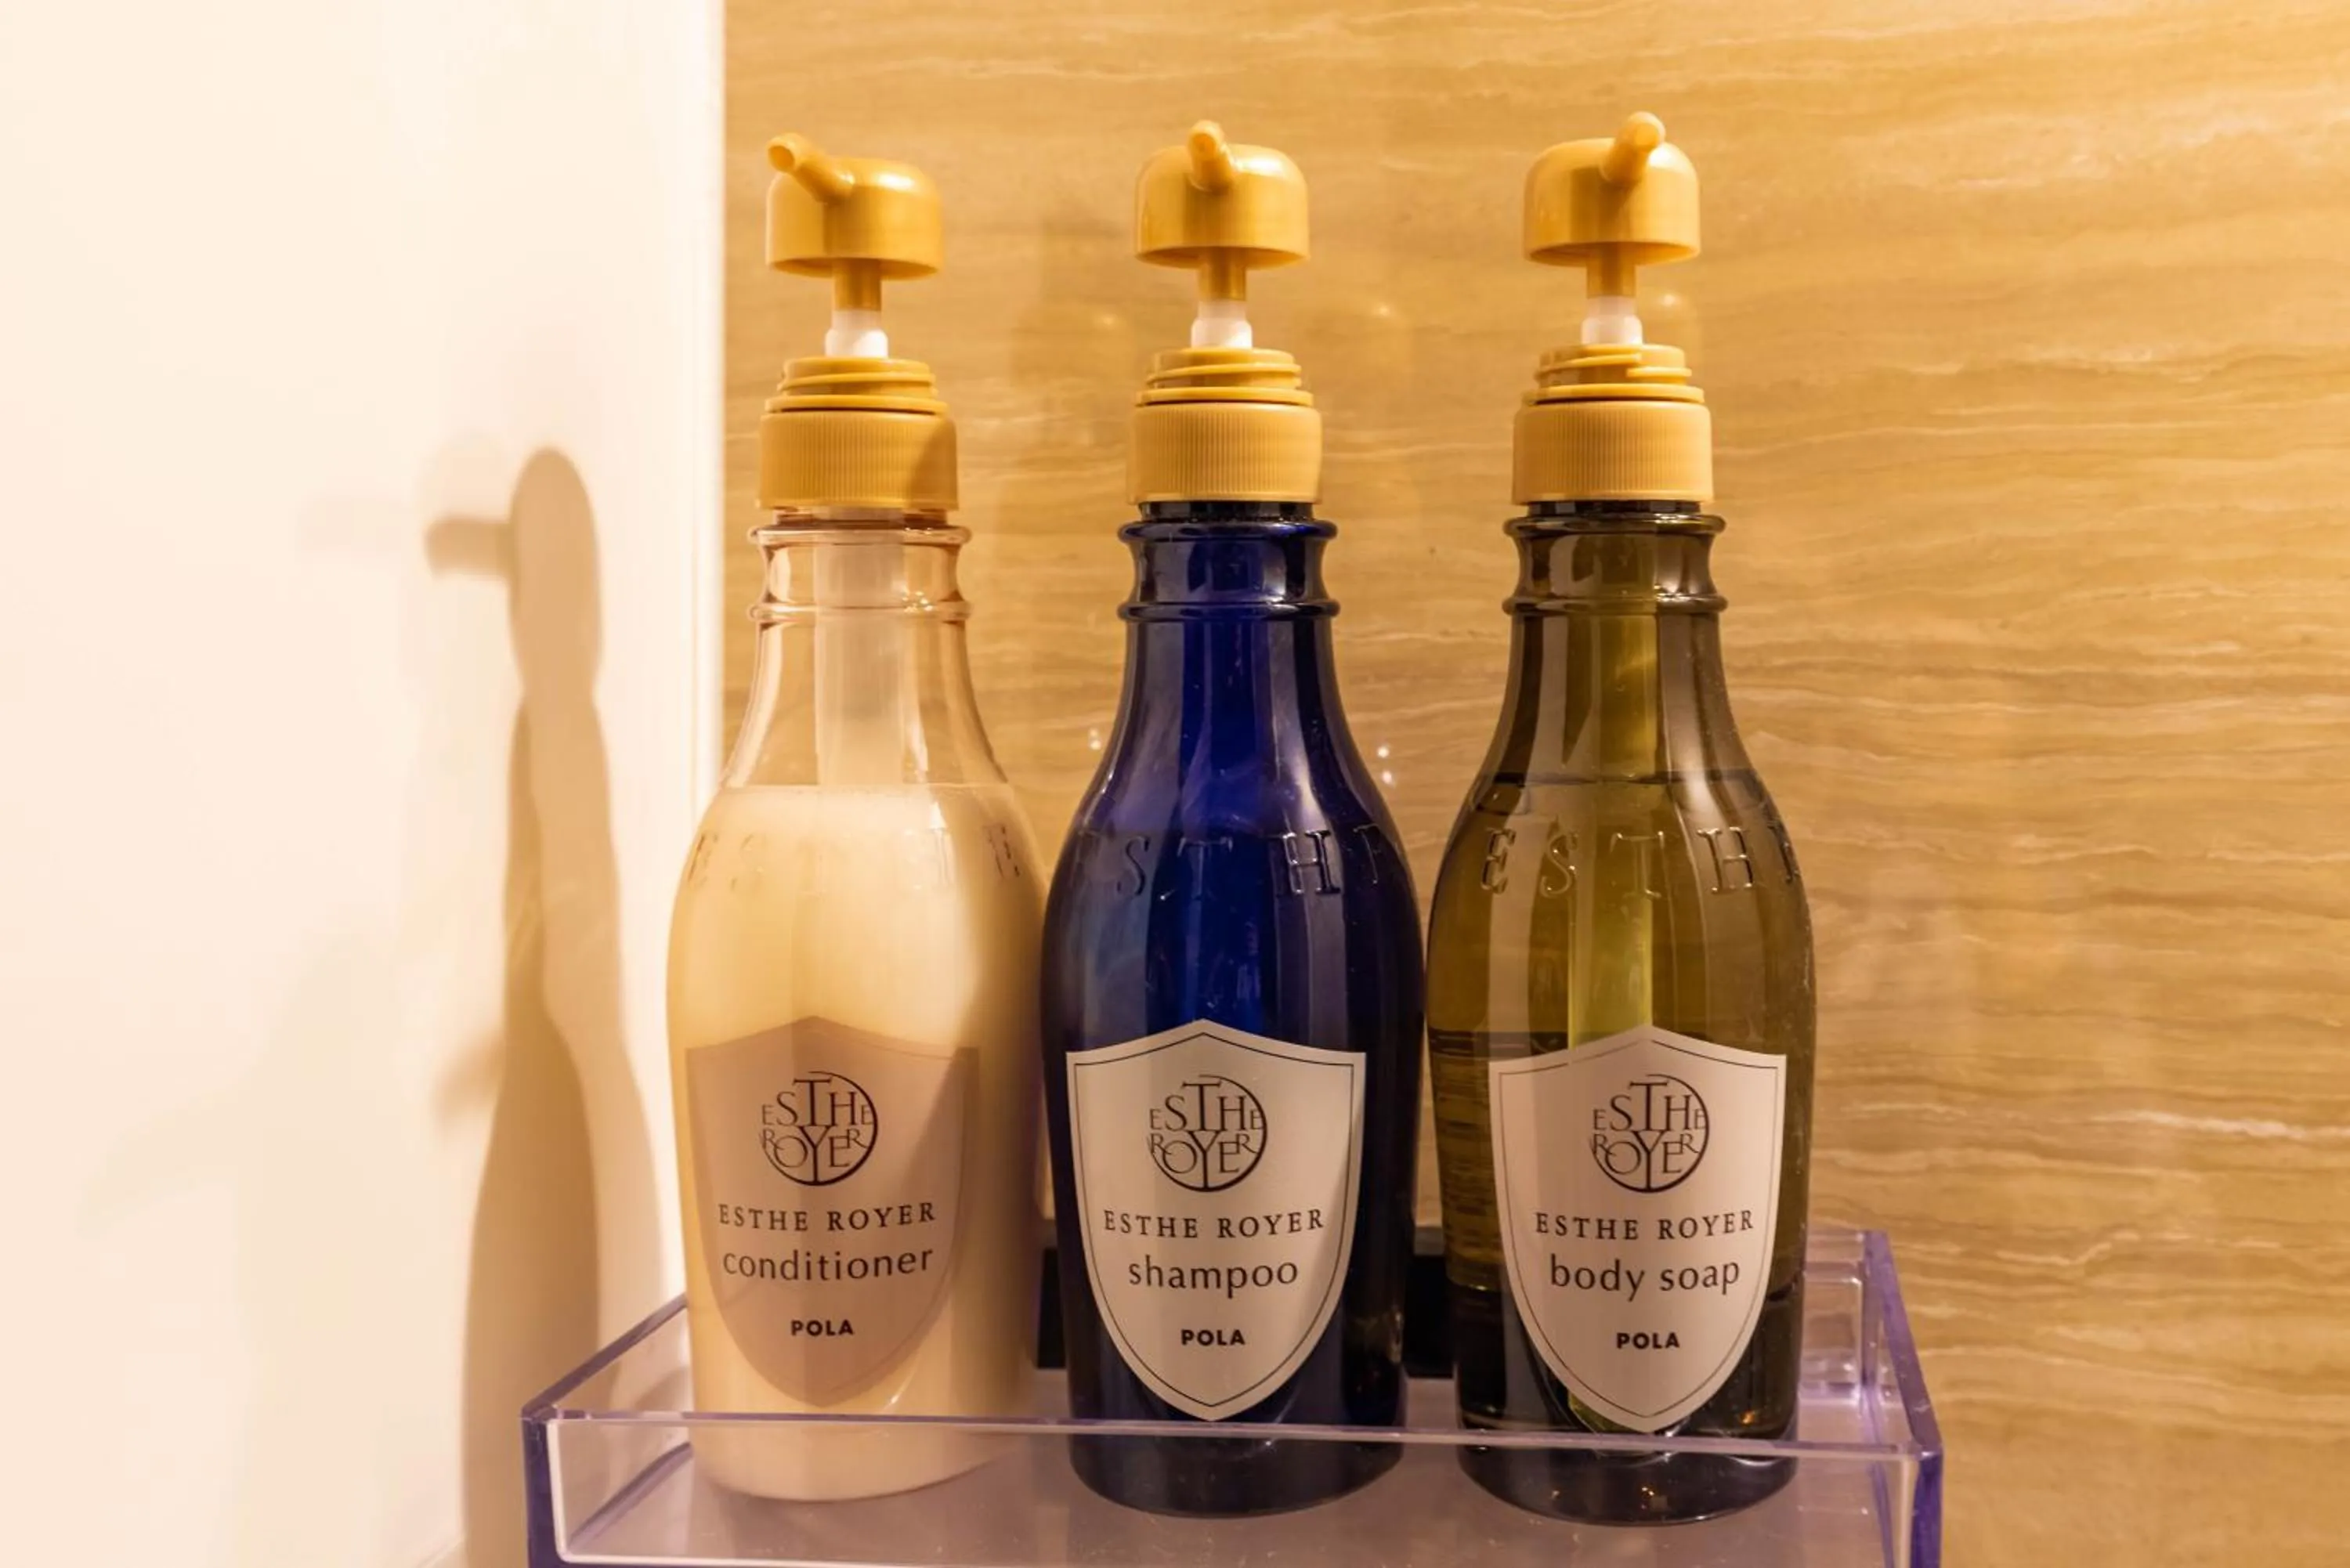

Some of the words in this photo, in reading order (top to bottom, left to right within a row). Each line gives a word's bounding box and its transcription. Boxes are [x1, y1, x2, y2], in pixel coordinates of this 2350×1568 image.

[761, 1078, 874, 1128] ESTHE
[1149, 1081, 1266, 1132] ESTHE
[1593, 1081, 1708, 1132] ESTHE
[718, 1203, 809, 1232] ESTHE
[826, 1201, 937, 1232] ROYER
[1103, 1209, 1198, 1239] ESTHE
[1217, 1208, 1325, 1239] ROYER
[1535, 1212, 1640, 1241] ESTHE
[1657, 1209, 1755, 1241] ROYER
[722, 1248, 934, 1281] conditioner
[1127, 1254, 1299, 1299] shampoo
[1549, 1253, 1646, 1302] body
[1658, 1259, 1741, 1296] soap
[790, 1319, 855, 1337] POLA
[1180, 1328, 1246, 1346] POLA
[1615, 1331, 1681, 1350] POLA
